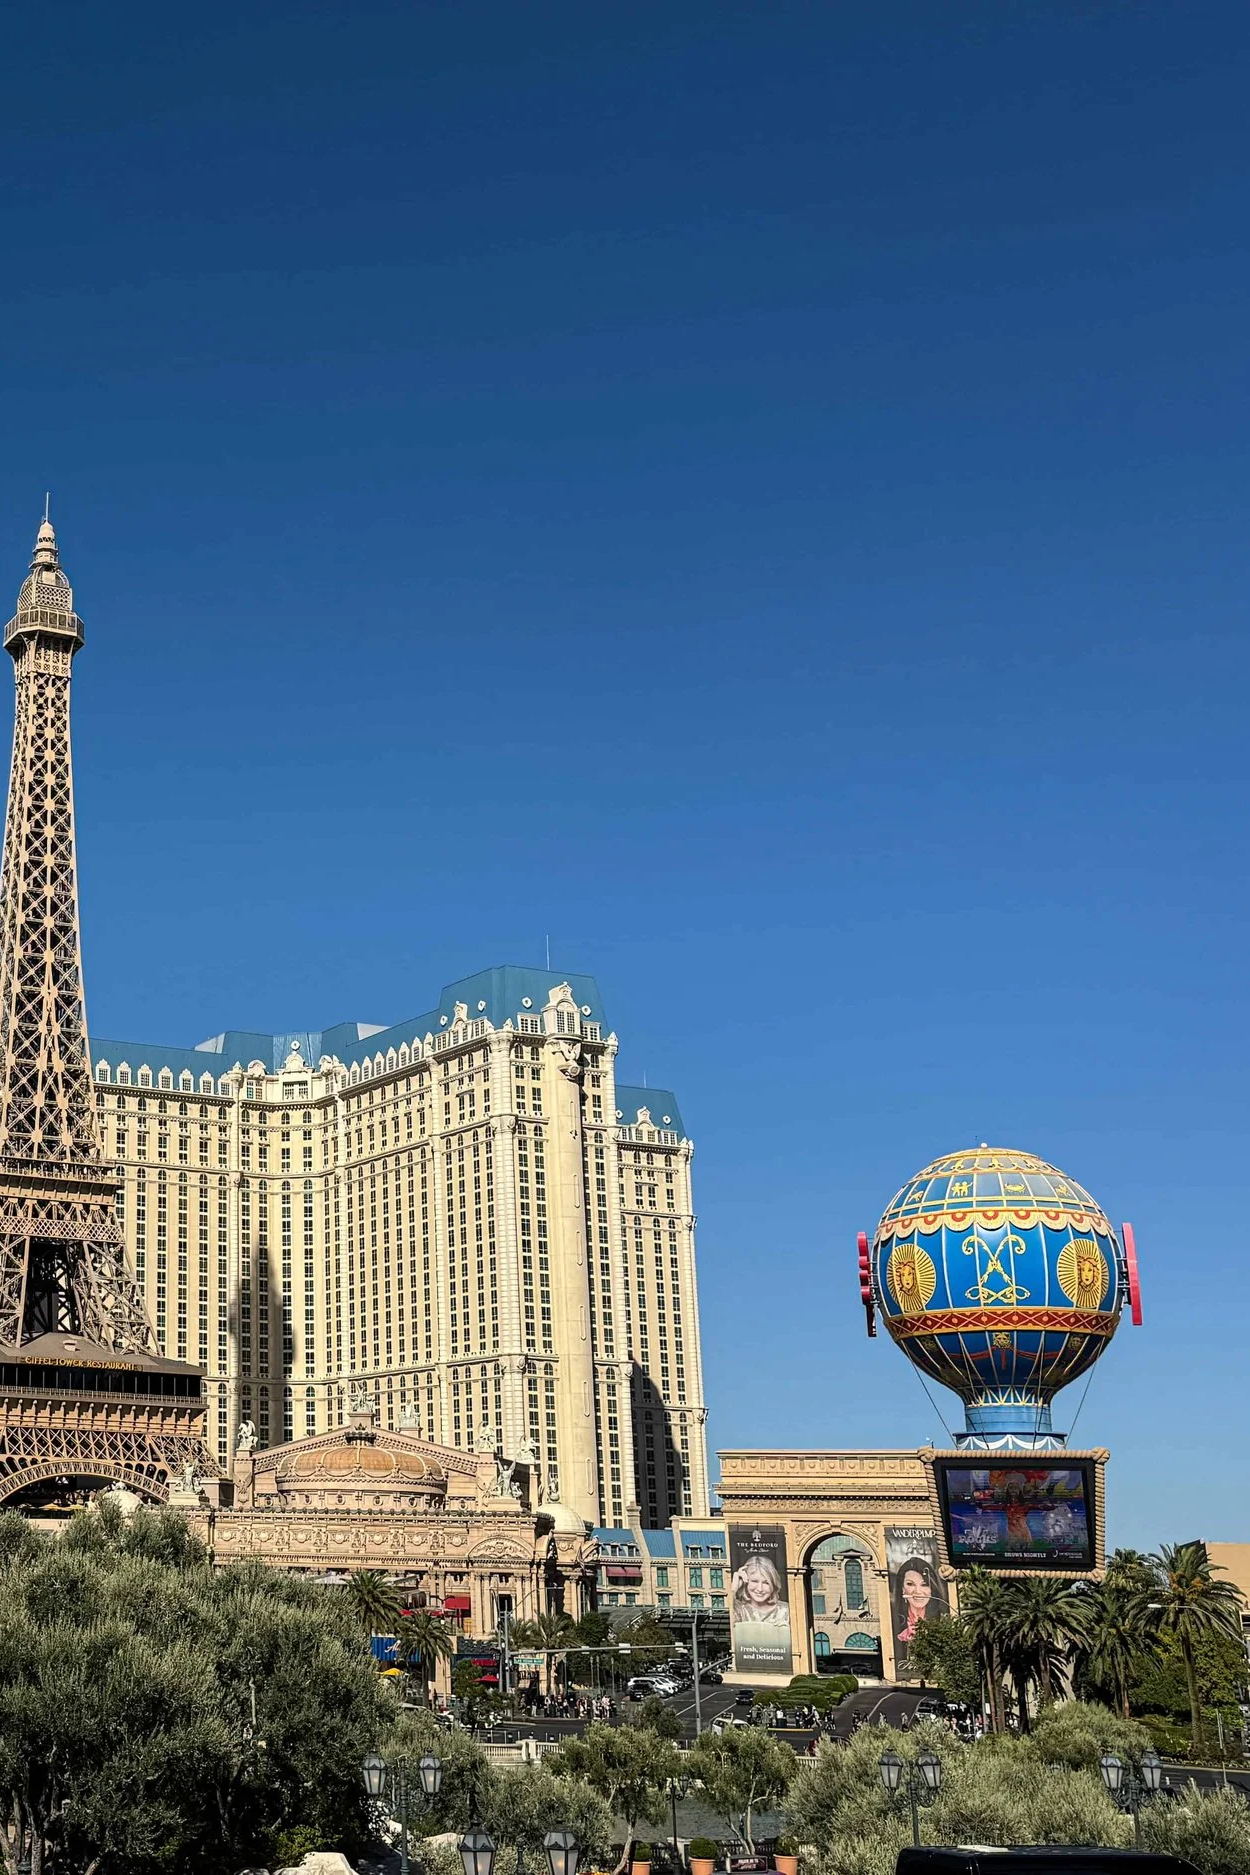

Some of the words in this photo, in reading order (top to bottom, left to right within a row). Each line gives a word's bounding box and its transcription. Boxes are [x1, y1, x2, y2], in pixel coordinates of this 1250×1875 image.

[25, 1356, 52, 1365] EIFFEL
[54, 1358, 83, 1367] TOWER
[87, 1361, 135, 1370] RESTAURANT
[892, 1529, 936, 1539] VANDERPUMP
